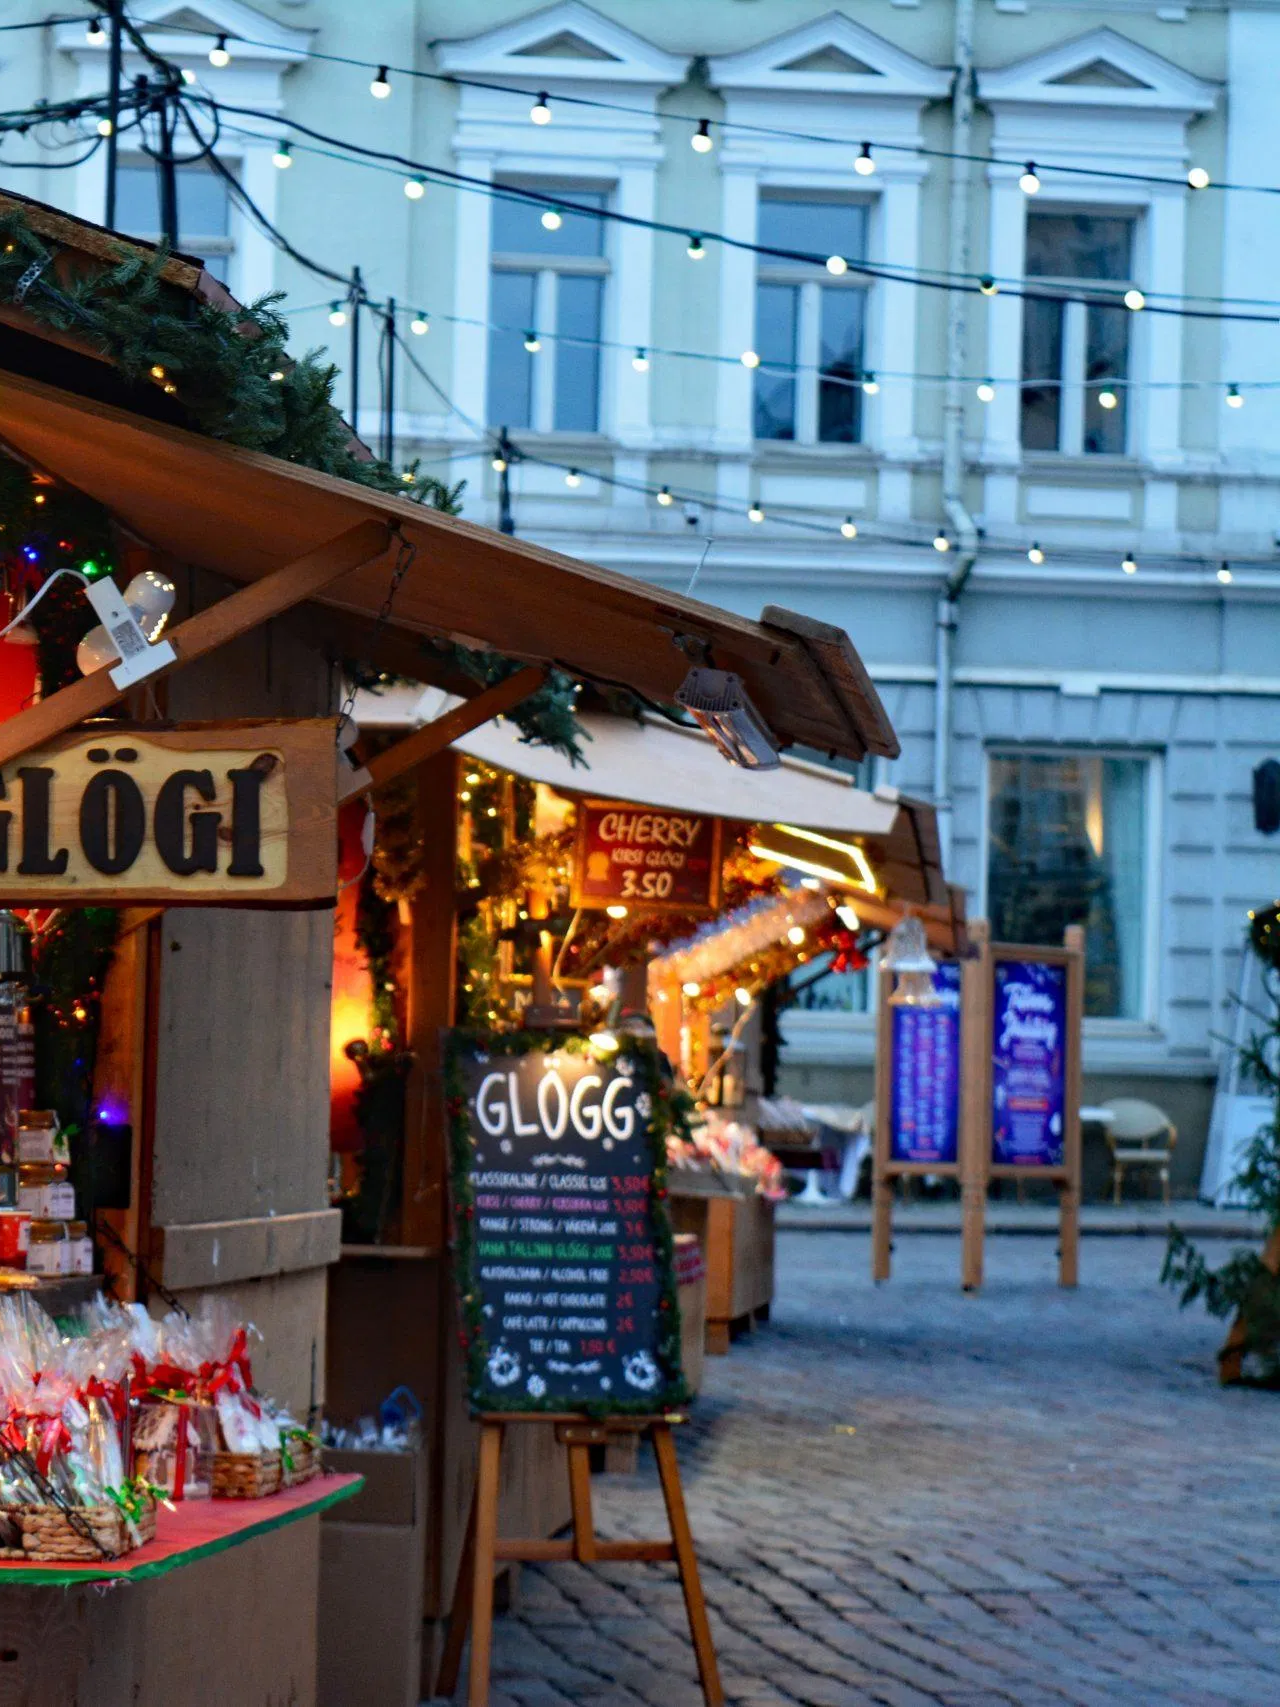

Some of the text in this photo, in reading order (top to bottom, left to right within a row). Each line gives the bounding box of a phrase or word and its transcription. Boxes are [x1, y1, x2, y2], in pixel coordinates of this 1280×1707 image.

[598, 812, 702, 847] CHERRY
[620, 869, 672, 898] 3.50
[549, 1174, 589, 1191] CLASSIC
